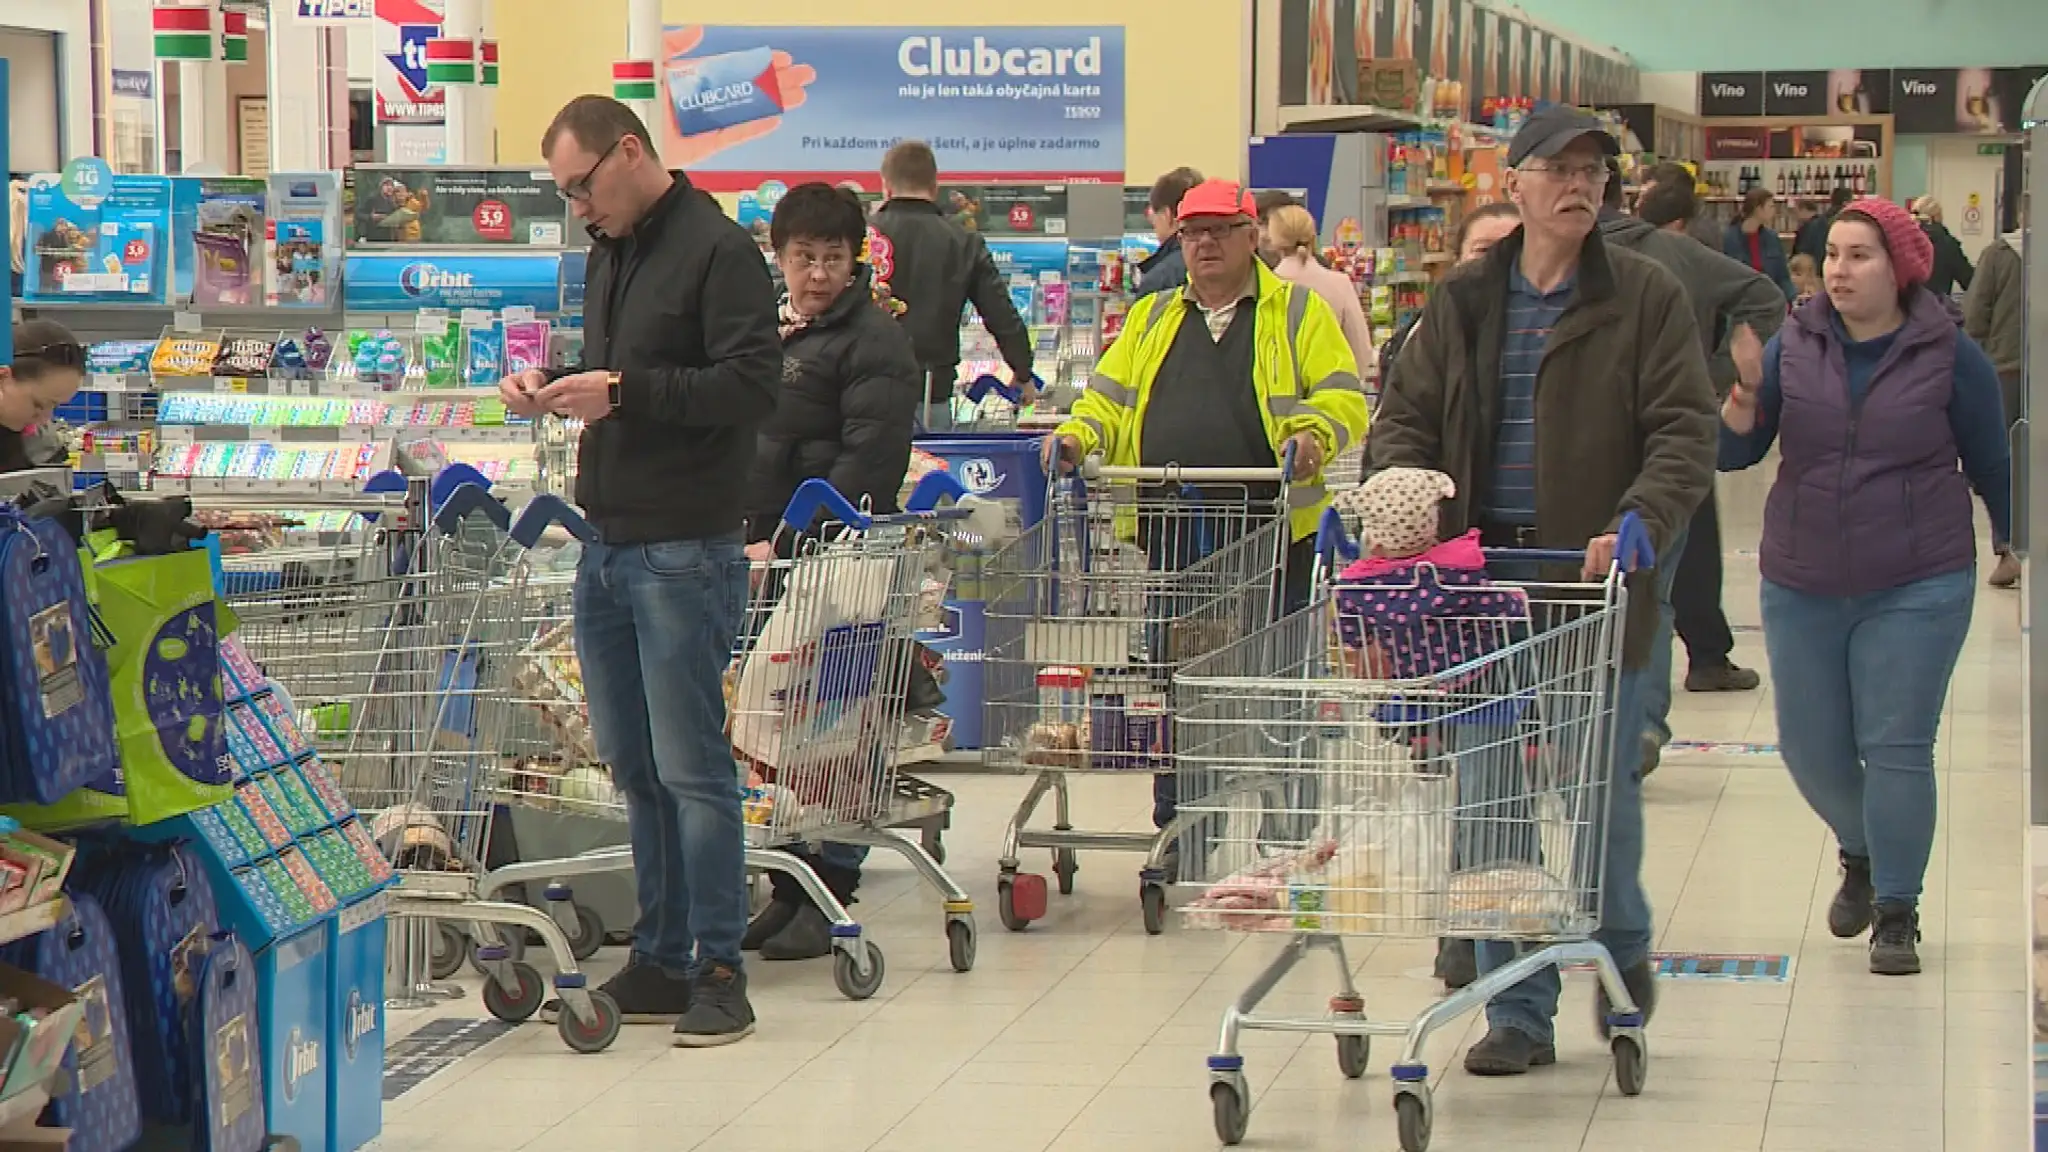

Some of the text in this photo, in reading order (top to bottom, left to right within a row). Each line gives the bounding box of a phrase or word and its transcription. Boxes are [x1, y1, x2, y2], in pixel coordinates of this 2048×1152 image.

[898, 36, 1101, 76] Clubcard
[679, 80, 754, 110] CLUBCARD
[899, 83, 1101, 99] nie je len taká obyčajná karta
[1711, 83, 1746, 97] Víno
[1773, 82, 1808, 97] Víno
[1901, 80, 1937, 96] Víno
[801, 136, 821, 149] Pri
[823, 136, 879, 149] každom
[972, 139, 981, 149] a
[982, 137, 995, 152] je
[999, 136, 1035, 152] úplne
[1039, 136, 1100, 149] zadarmo
[74, 170, 99, 185] 4G
[480, 211, 504, 227] 3,9
[407, 263, 473, 290] Orbit
